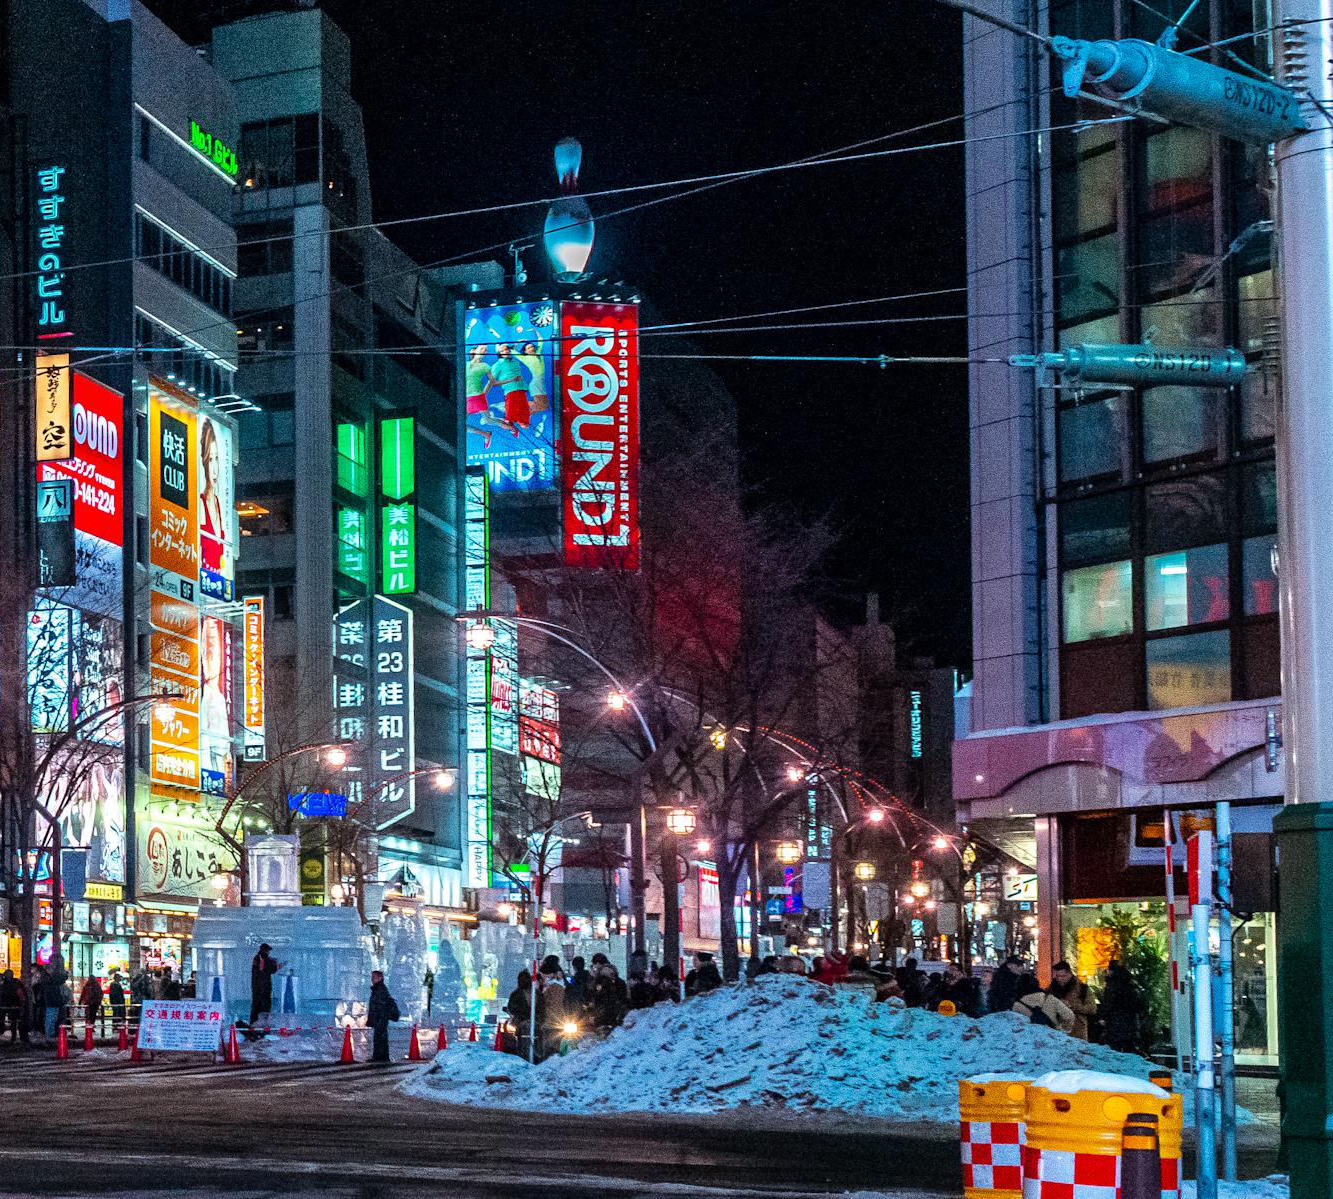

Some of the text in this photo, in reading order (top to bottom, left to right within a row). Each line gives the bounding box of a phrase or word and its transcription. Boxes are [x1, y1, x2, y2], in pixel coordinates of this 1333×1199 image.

[37, 165, 67, 326] すすきのビル
[567, 325, 632, 547] ROUND1
[618, 329, 629, 522] SPORTS ENTERTAINMENT
[162, 428, 185, 466] 快活
[163, 467, 185, 492] CLUB
[161, 508, 188, 536] コミック
[151, 530, 198, 563] インターネット
[388, 506, 410, 591] 美松ビル
[377, 619, 405, 803] 第23桂和ビル
[247, 747, 261, 757] 9F
[473, 845, 484, 885] HAPPY
[145, 1008, 222, 1022] 交通規制案内
